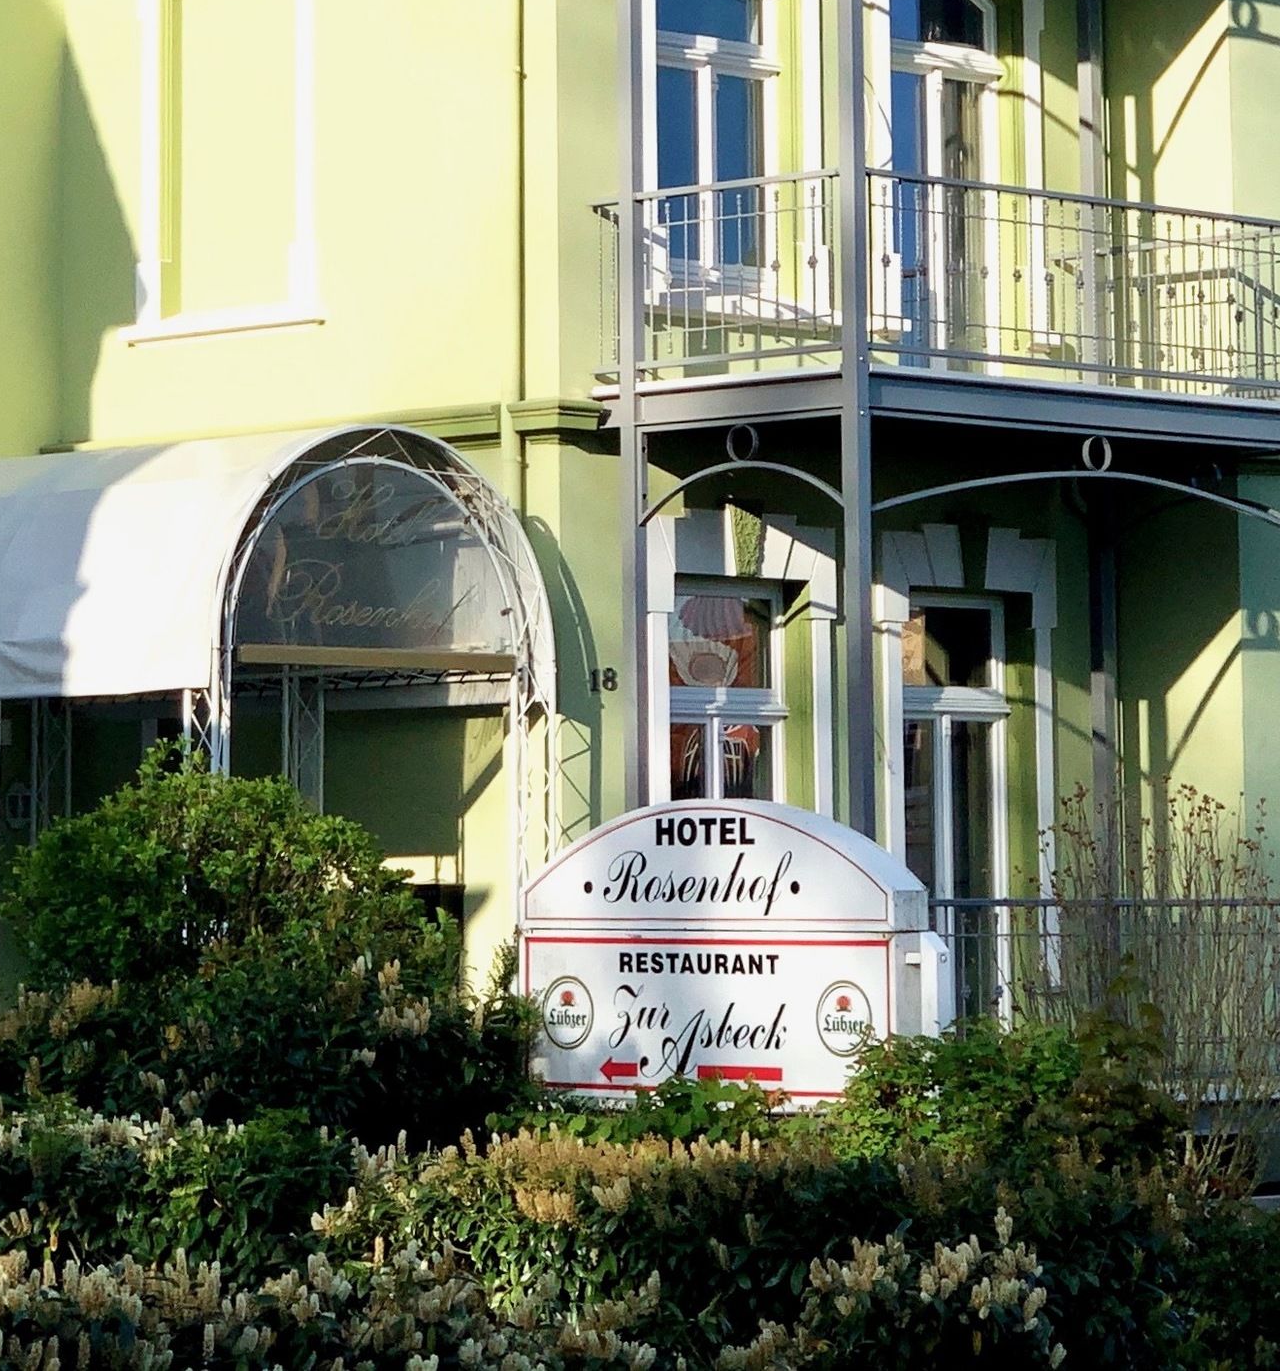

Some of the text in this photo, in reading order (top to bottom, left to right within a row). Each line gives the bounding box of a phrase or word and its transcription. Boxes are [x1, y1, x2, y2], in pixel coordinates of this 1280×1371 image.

[590, 667, 618, 692] 18
[655, 817, 755, 846] HOTEL
[603, 850, 793, 916] Rosenhof
[619, 952, 780, 975] RESTAURANT
[548, 1008, 587, 1030] Lübzer
[609, 984, 787, 1077] Zur Asbeck
[823, 1013, 865, 1035] Lübzer
